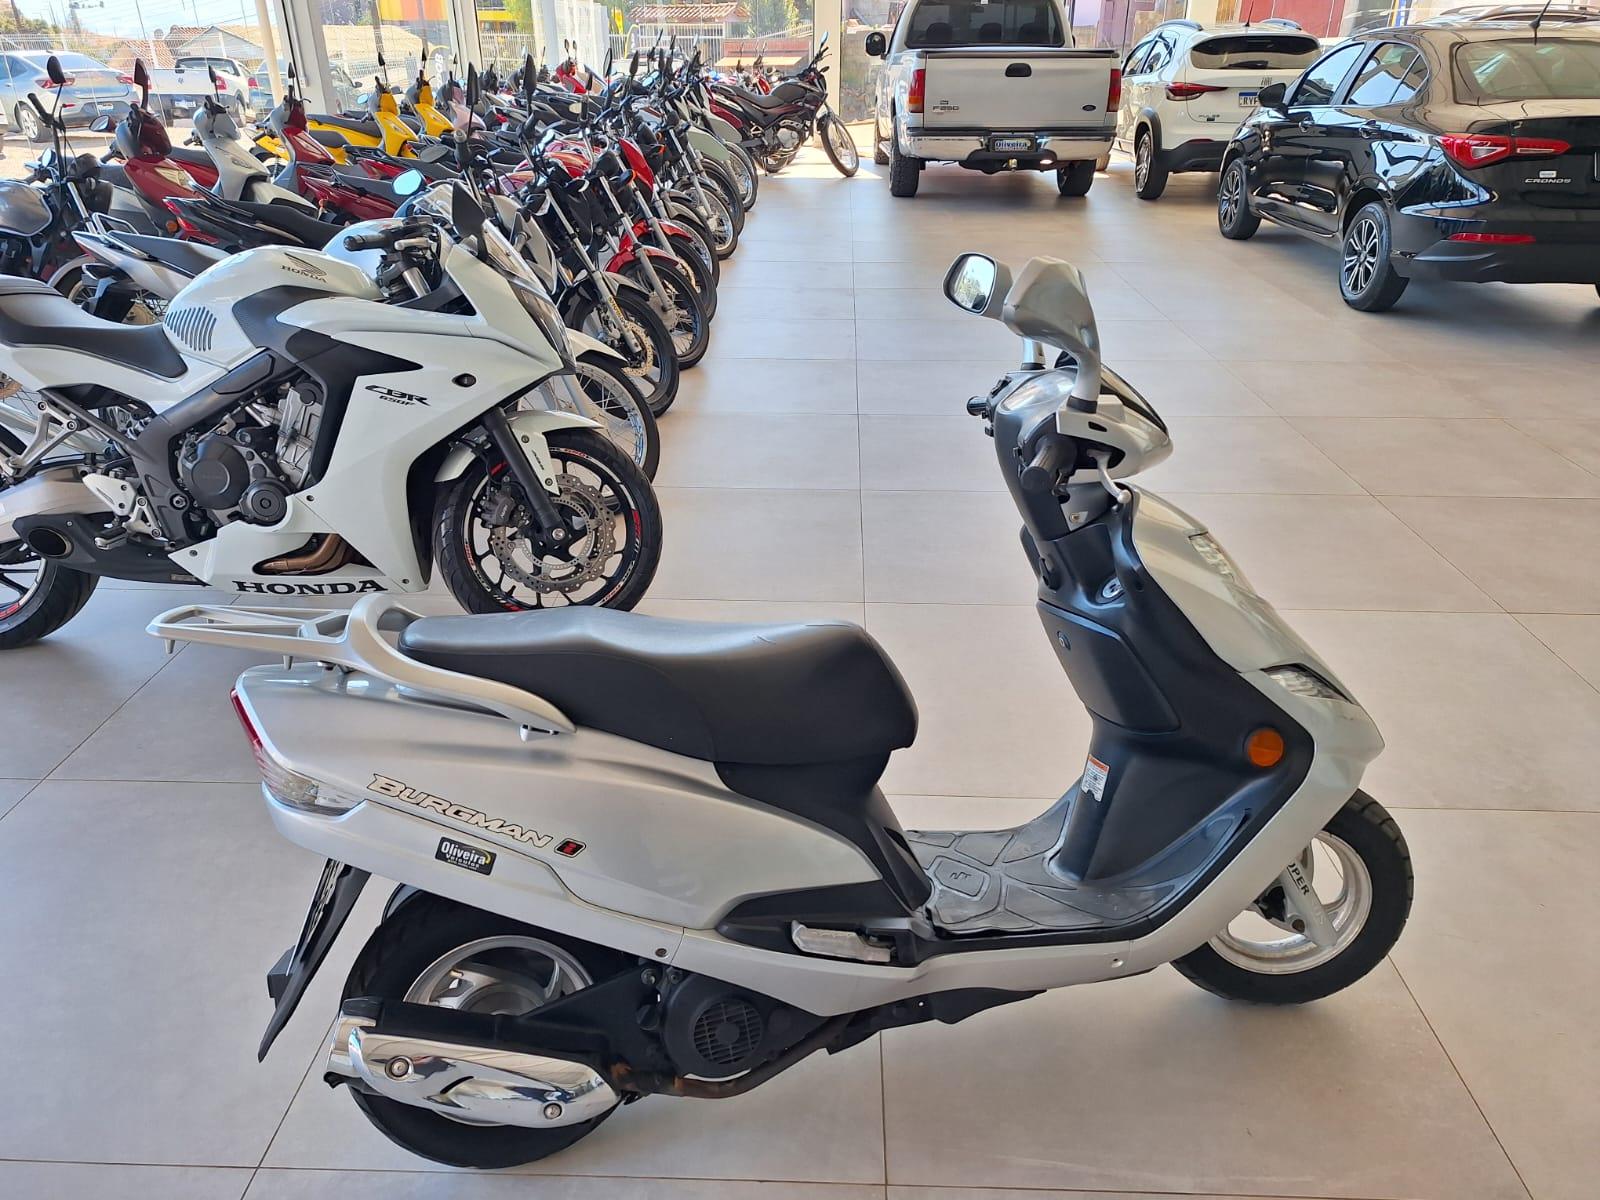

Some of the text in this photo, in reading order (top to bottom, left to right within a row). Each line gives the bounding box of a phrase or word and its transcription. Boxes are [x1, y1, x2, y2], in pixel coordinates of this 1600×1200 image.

[280, 265, 329, 283] HONDA
[364, 384, 431, 407] CBR
[231, 579, 388, 595] HONDA
[366, 773, 553, 848] BURGMAN
[441, 841, 487, 866] Oliveira
